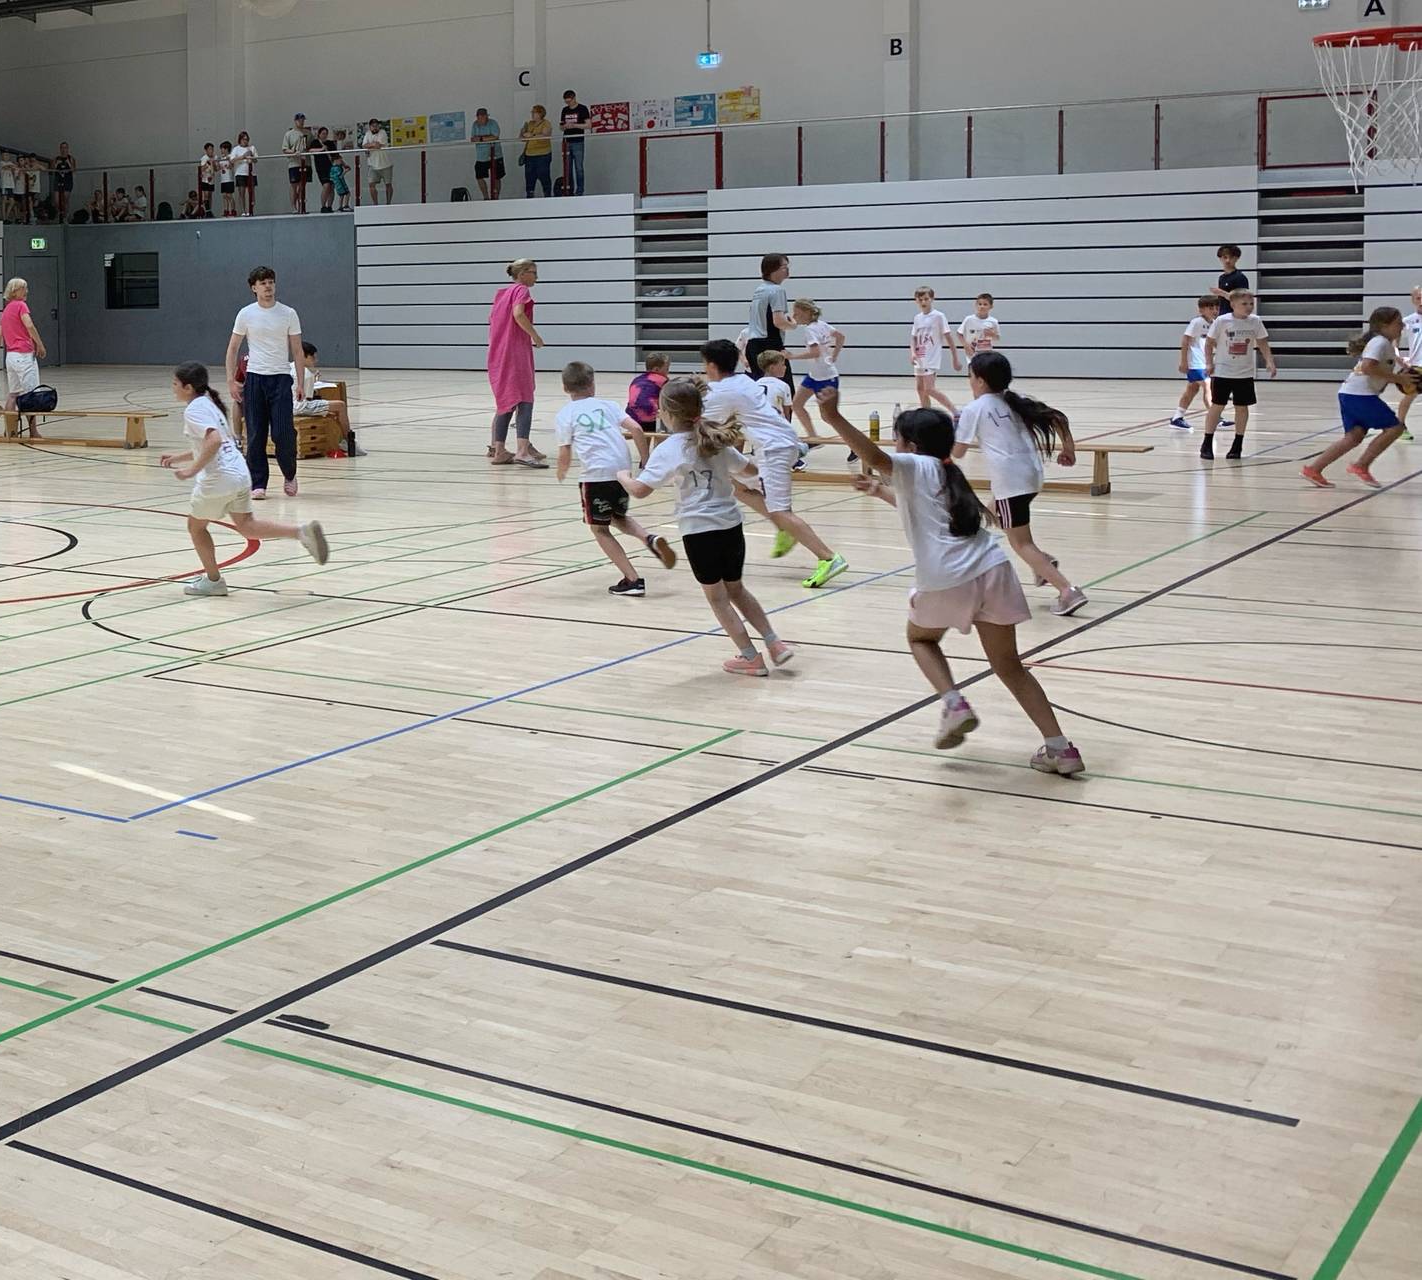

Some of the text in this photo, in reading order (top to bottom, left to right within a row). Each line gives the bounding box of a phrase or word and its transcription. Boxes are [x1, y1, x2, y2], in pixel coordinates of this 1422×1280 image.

[1363, 0, 1386, 17] A
[890, 38, 903, 56] B
[518, 70, 530, 87] C
[688, 469, 713, 490] 17
